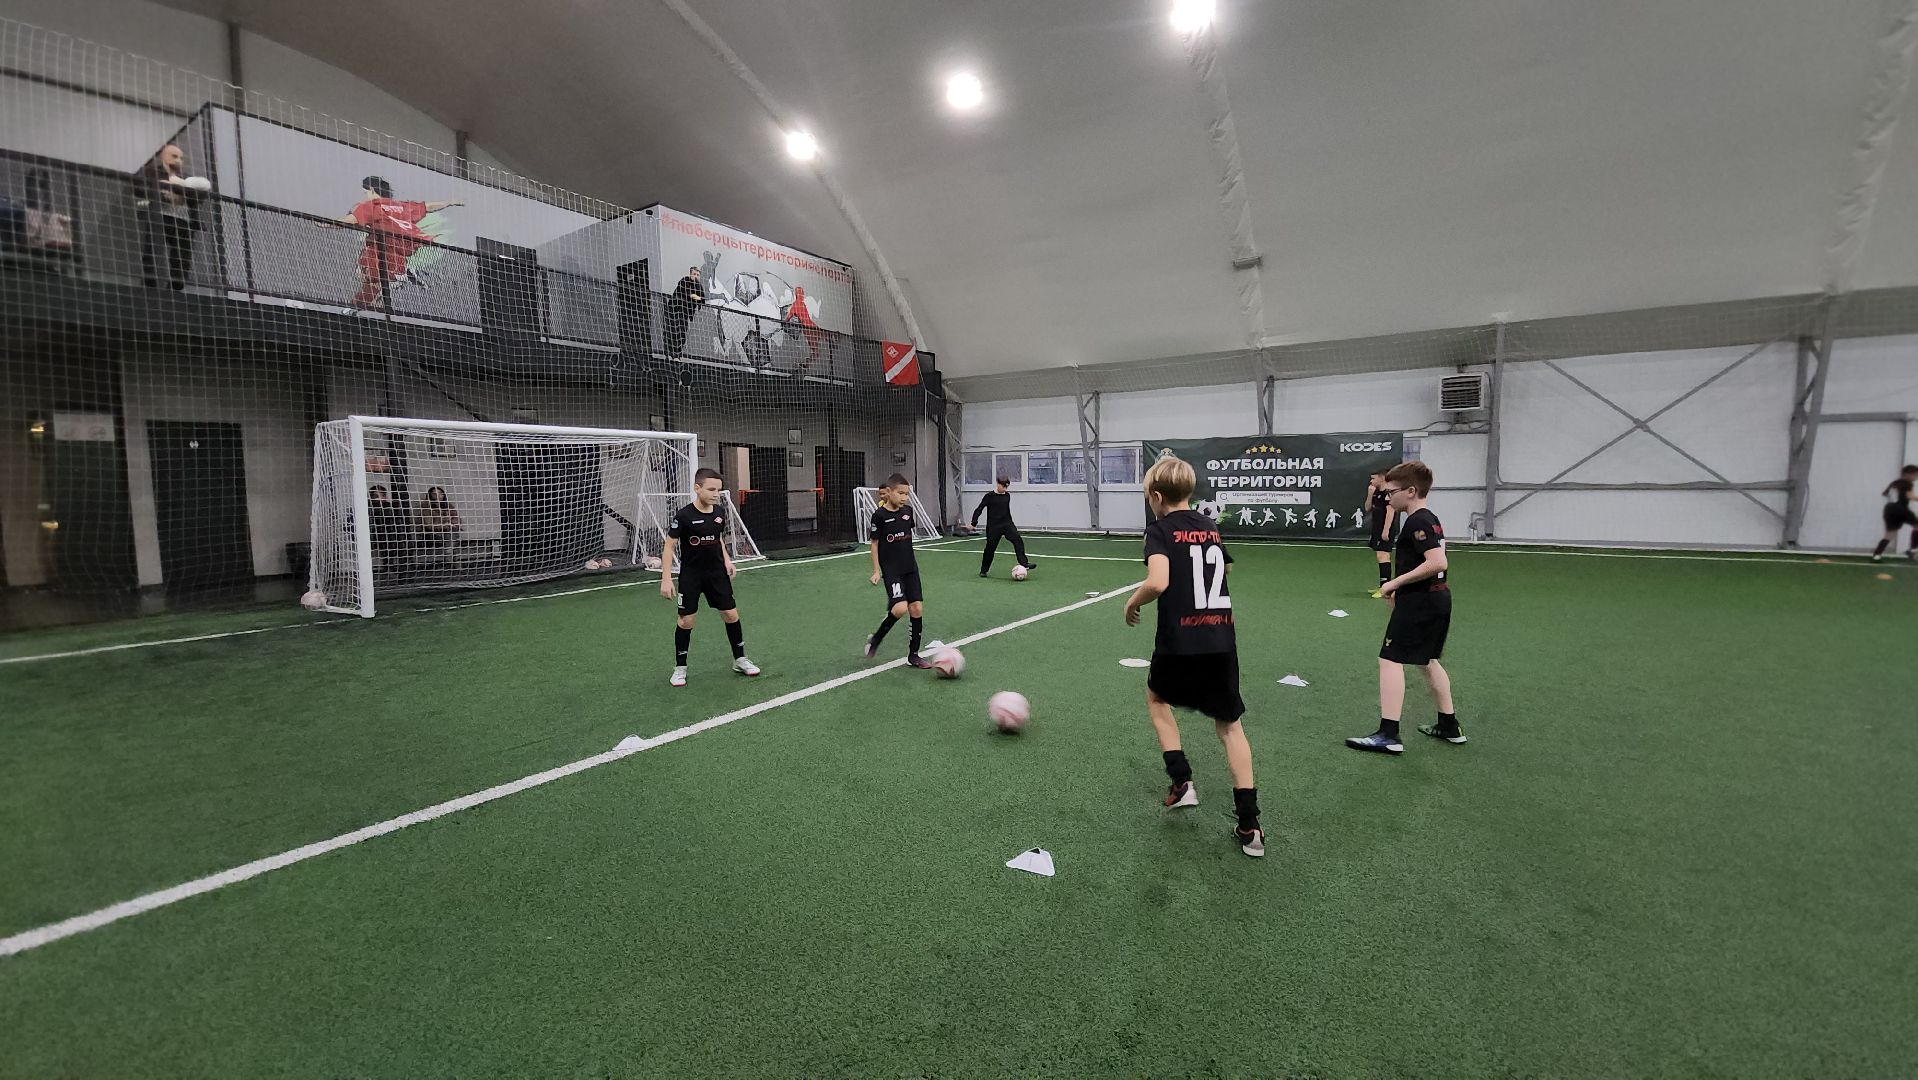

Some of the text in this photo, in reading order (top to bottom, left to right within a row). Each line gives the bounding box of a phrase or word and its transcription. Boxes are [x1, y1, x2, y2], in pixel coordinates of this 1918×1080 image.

[1339, 441, 1393, 453] KODES
[1206, 457, 1324, 471] ФУТБОЛЬНАЯ
[1207, 475, 1322, 488] ТЕРРИТОРИЯ
[1189, 545, 1232, 610] 12
